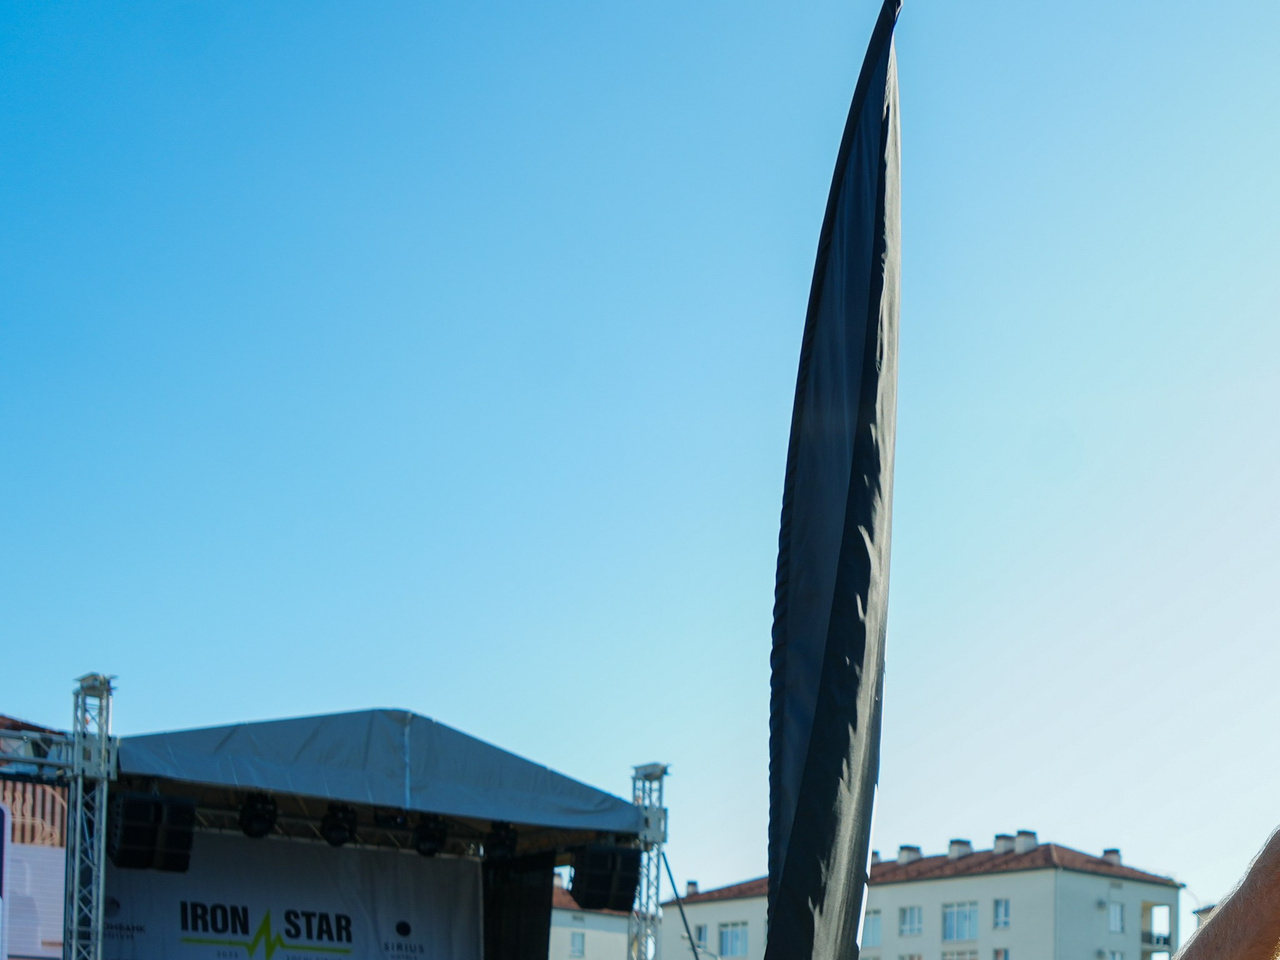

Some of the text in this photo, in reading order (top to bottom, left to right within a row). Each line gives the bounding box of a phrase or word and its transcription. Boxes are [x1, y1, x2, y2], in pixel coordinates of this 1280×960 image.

[180, 901, 352, 943] IRON STAR
[383, 942, 425, 953] SIRIUS
